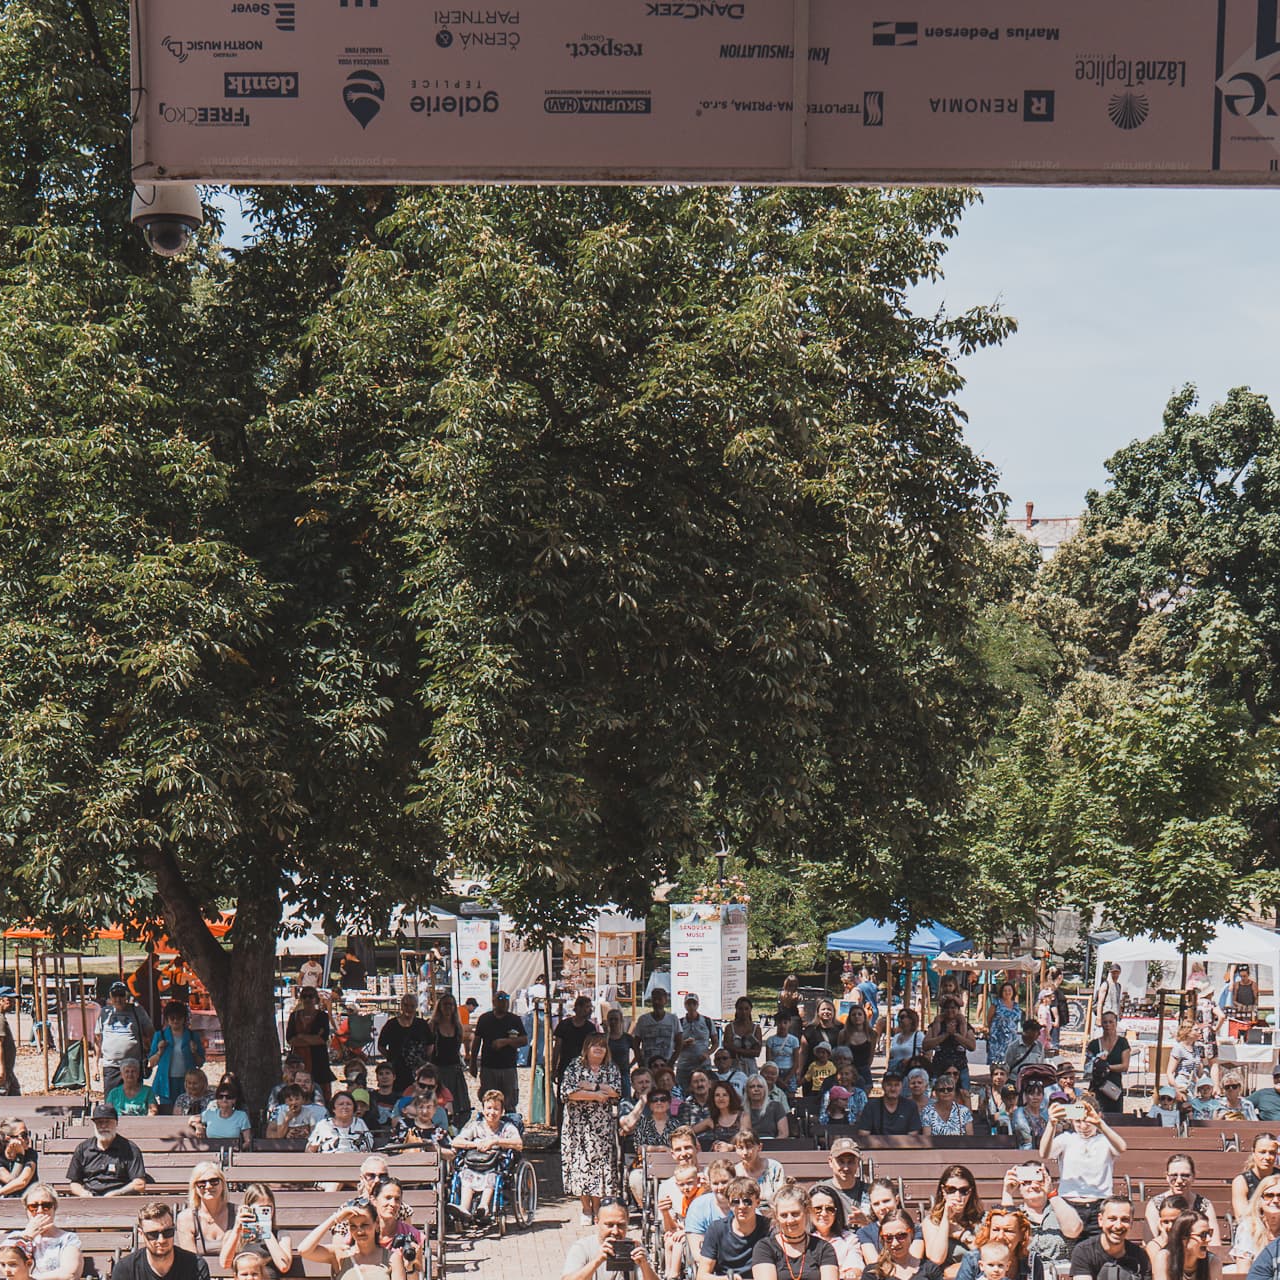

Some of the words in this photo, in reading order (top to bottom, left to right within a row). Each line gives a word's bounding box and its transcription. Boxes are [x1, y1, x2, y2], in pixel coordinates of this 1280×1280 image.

[231, 4, 270, 16] Sever
[434, 10, 520, 29] PARTNEŘI
[924, 28, 999, 40] Pedersen
[1006, 28, 1060, 40] Marius
[186, 40, 221, 50] MUSIC
[224, 40, 263, 50] NORTH
[459, 32, 520, 50] ČERNÁ
[566, 38, 642, 60] respect.
[226, 75, 296, 95] deník
[410, 80, 481, 89] TEPLICE
[410, 90, 499, 117] galerie
[582, 100, 646, 111] SKUPINA
[928, 98, 1018, 112] RENOMIA
[164, 107, 244, 124] FREEČKO
